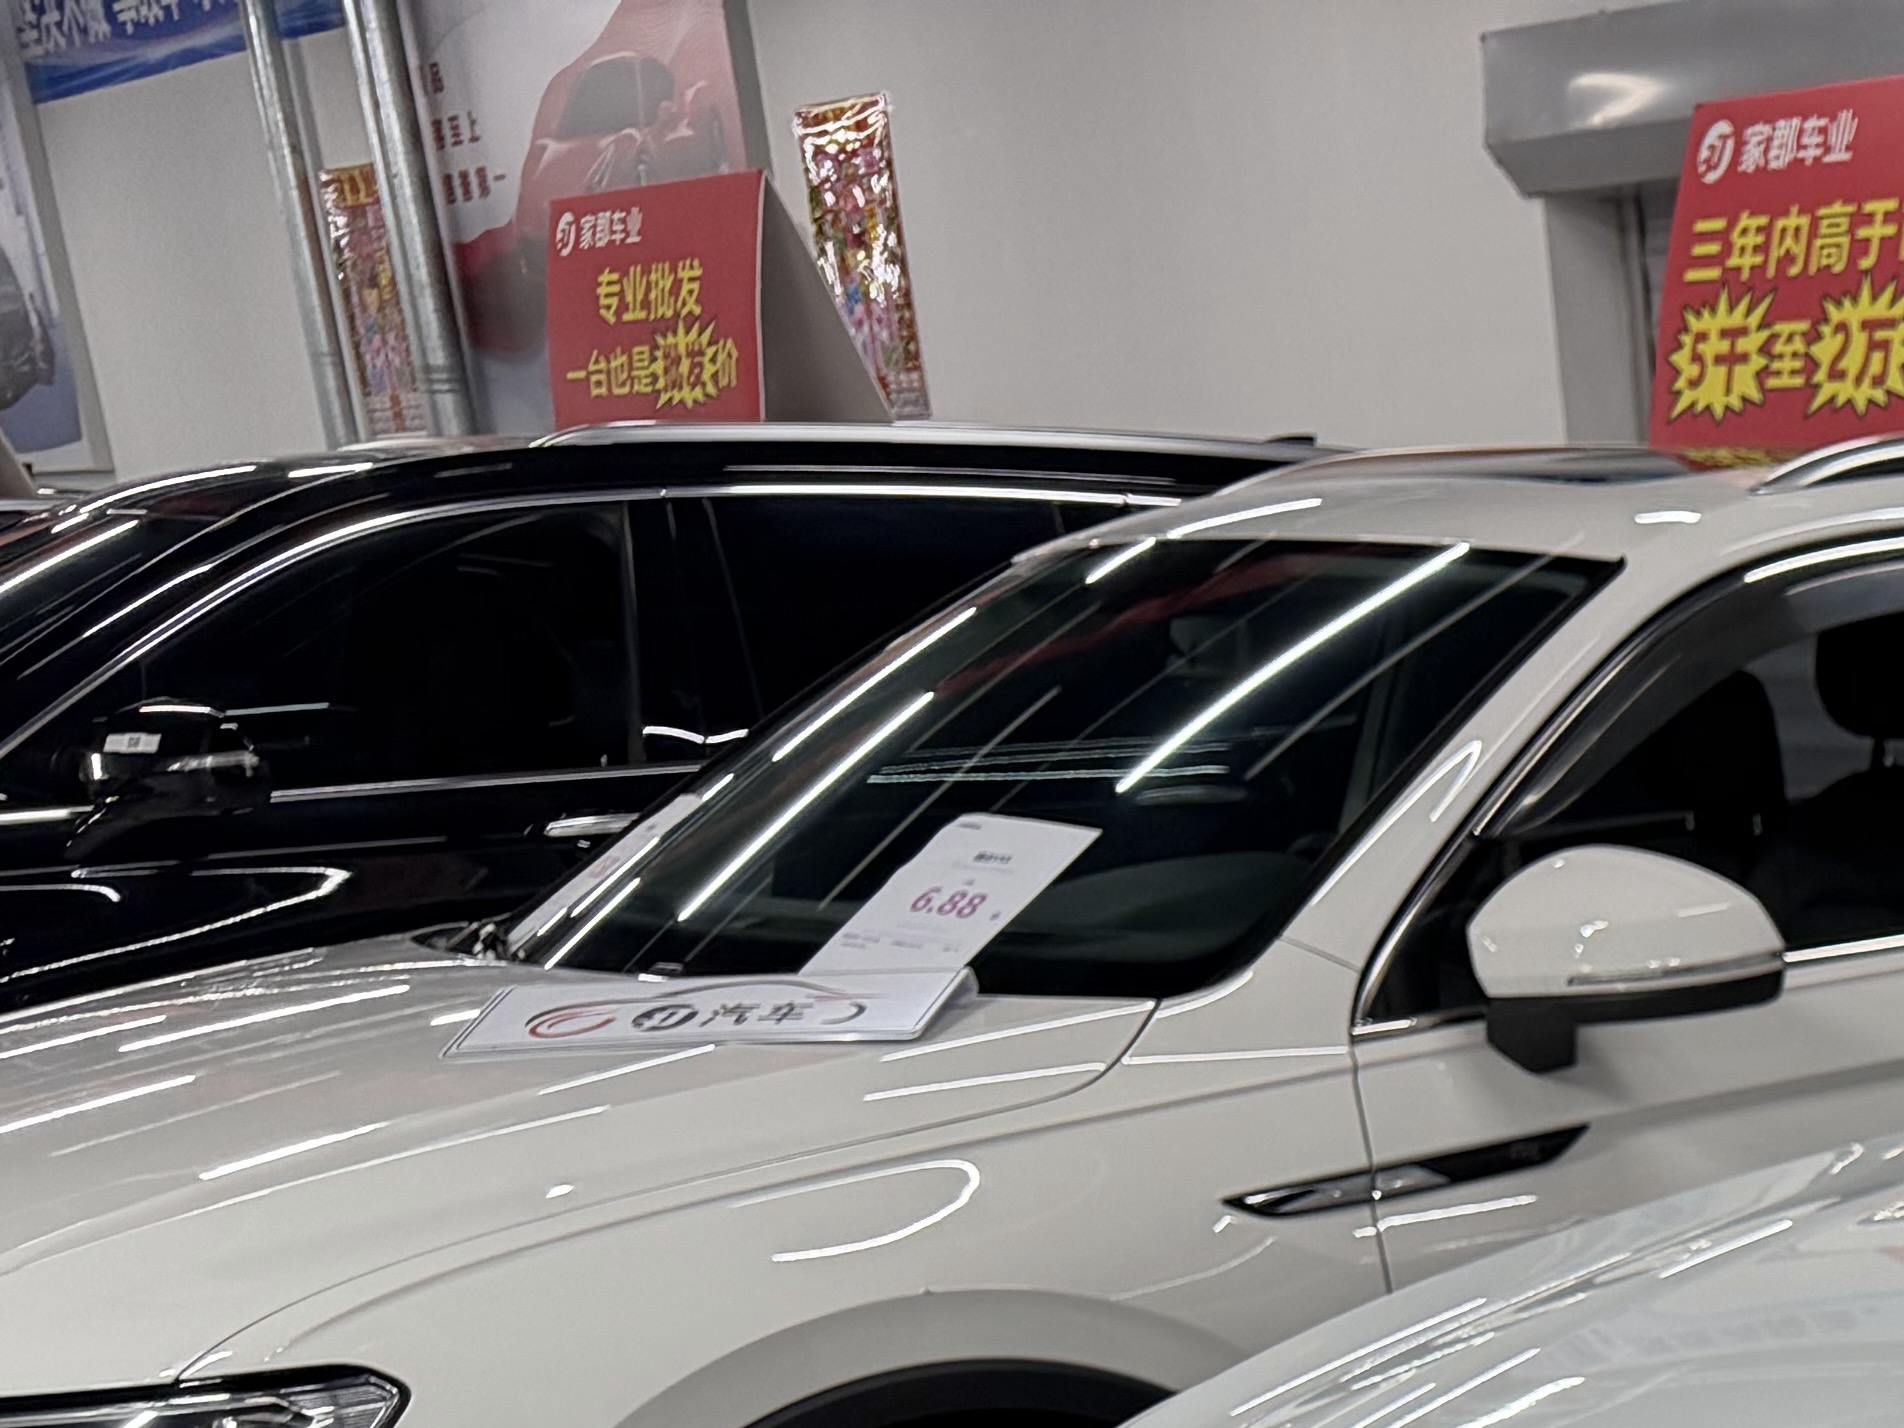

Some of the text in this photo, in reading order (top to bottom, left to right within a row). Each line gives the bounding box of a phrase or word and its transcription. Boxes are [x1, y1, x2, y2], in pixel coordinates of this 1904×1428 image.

[596, 257, 702, 326] 专业批发
[910, 886, 987, 919] 6.88
[700, 1000, 813, 1027] 汽车
